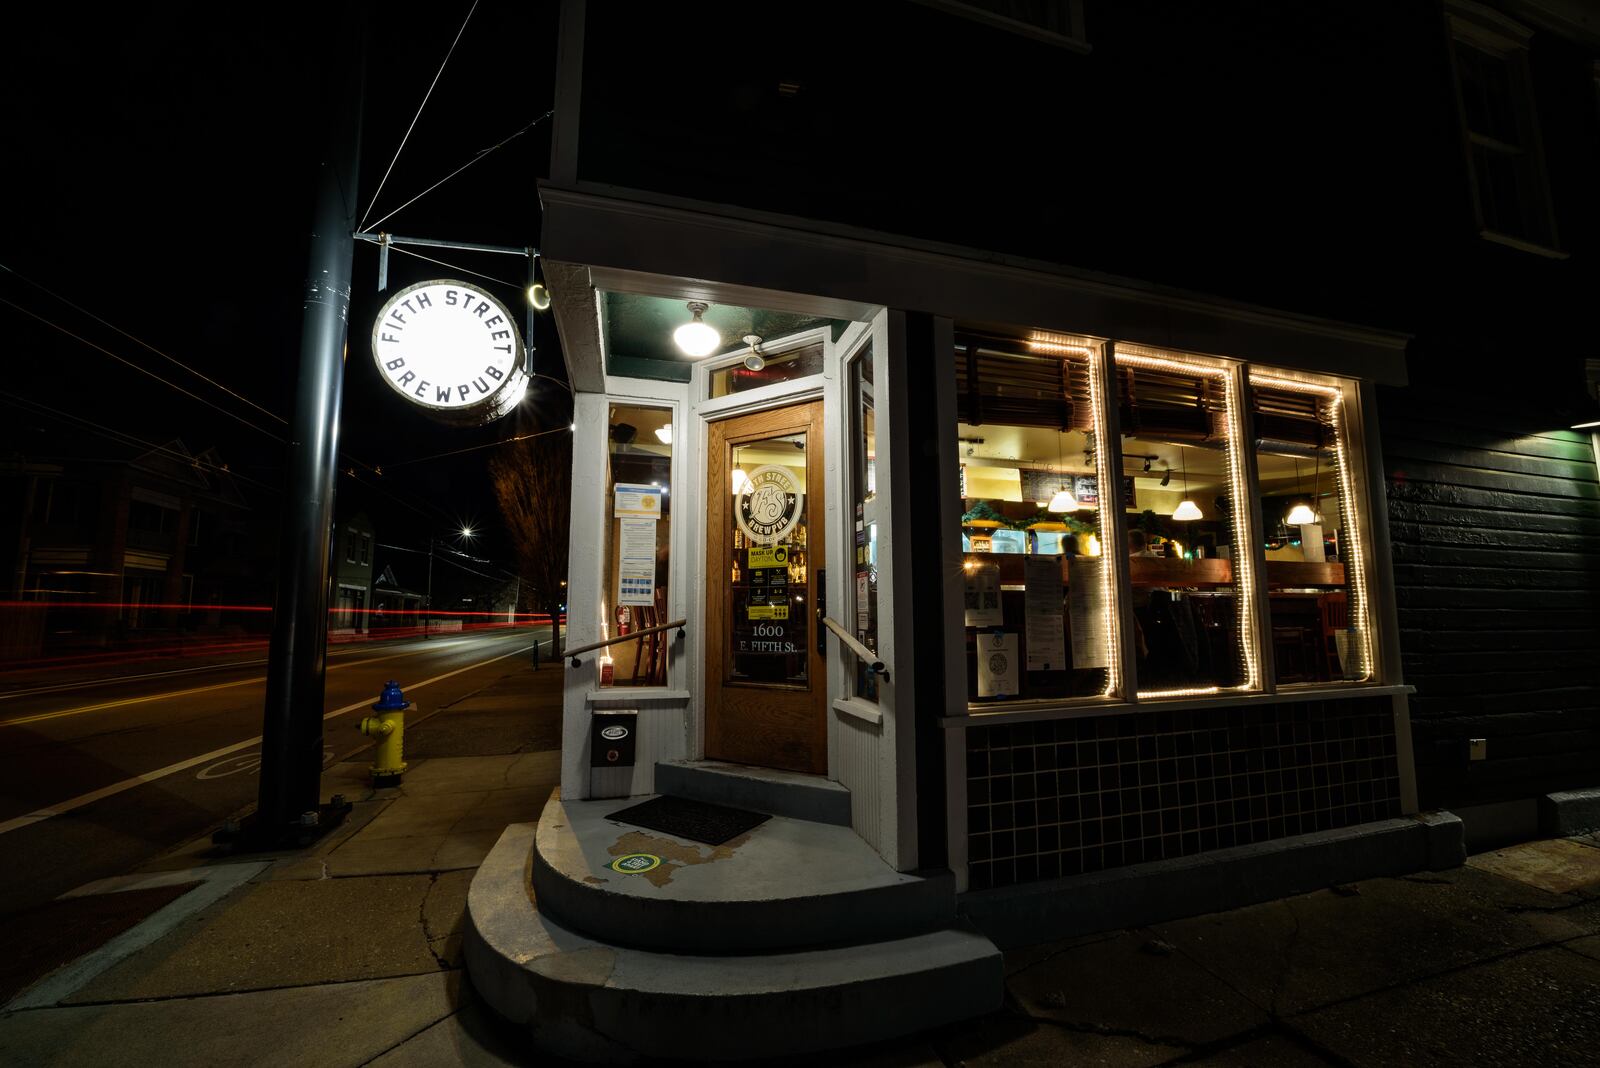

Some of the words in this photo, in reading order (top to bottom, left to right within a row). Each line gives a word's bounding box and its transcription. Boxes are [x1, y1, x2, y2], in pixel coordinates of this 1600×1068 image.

[381, 292, 432, 343] FIFTH
[445, 290, 512, 354] STREET
[386, 357, 504, 403] BREWPUB
[748, 516, 788, 535] BREWPUB
[752, 623, 784, 637] 1600
[751, 641, 783, 652] FIFTH
[784, 641, 798, 653] St.
